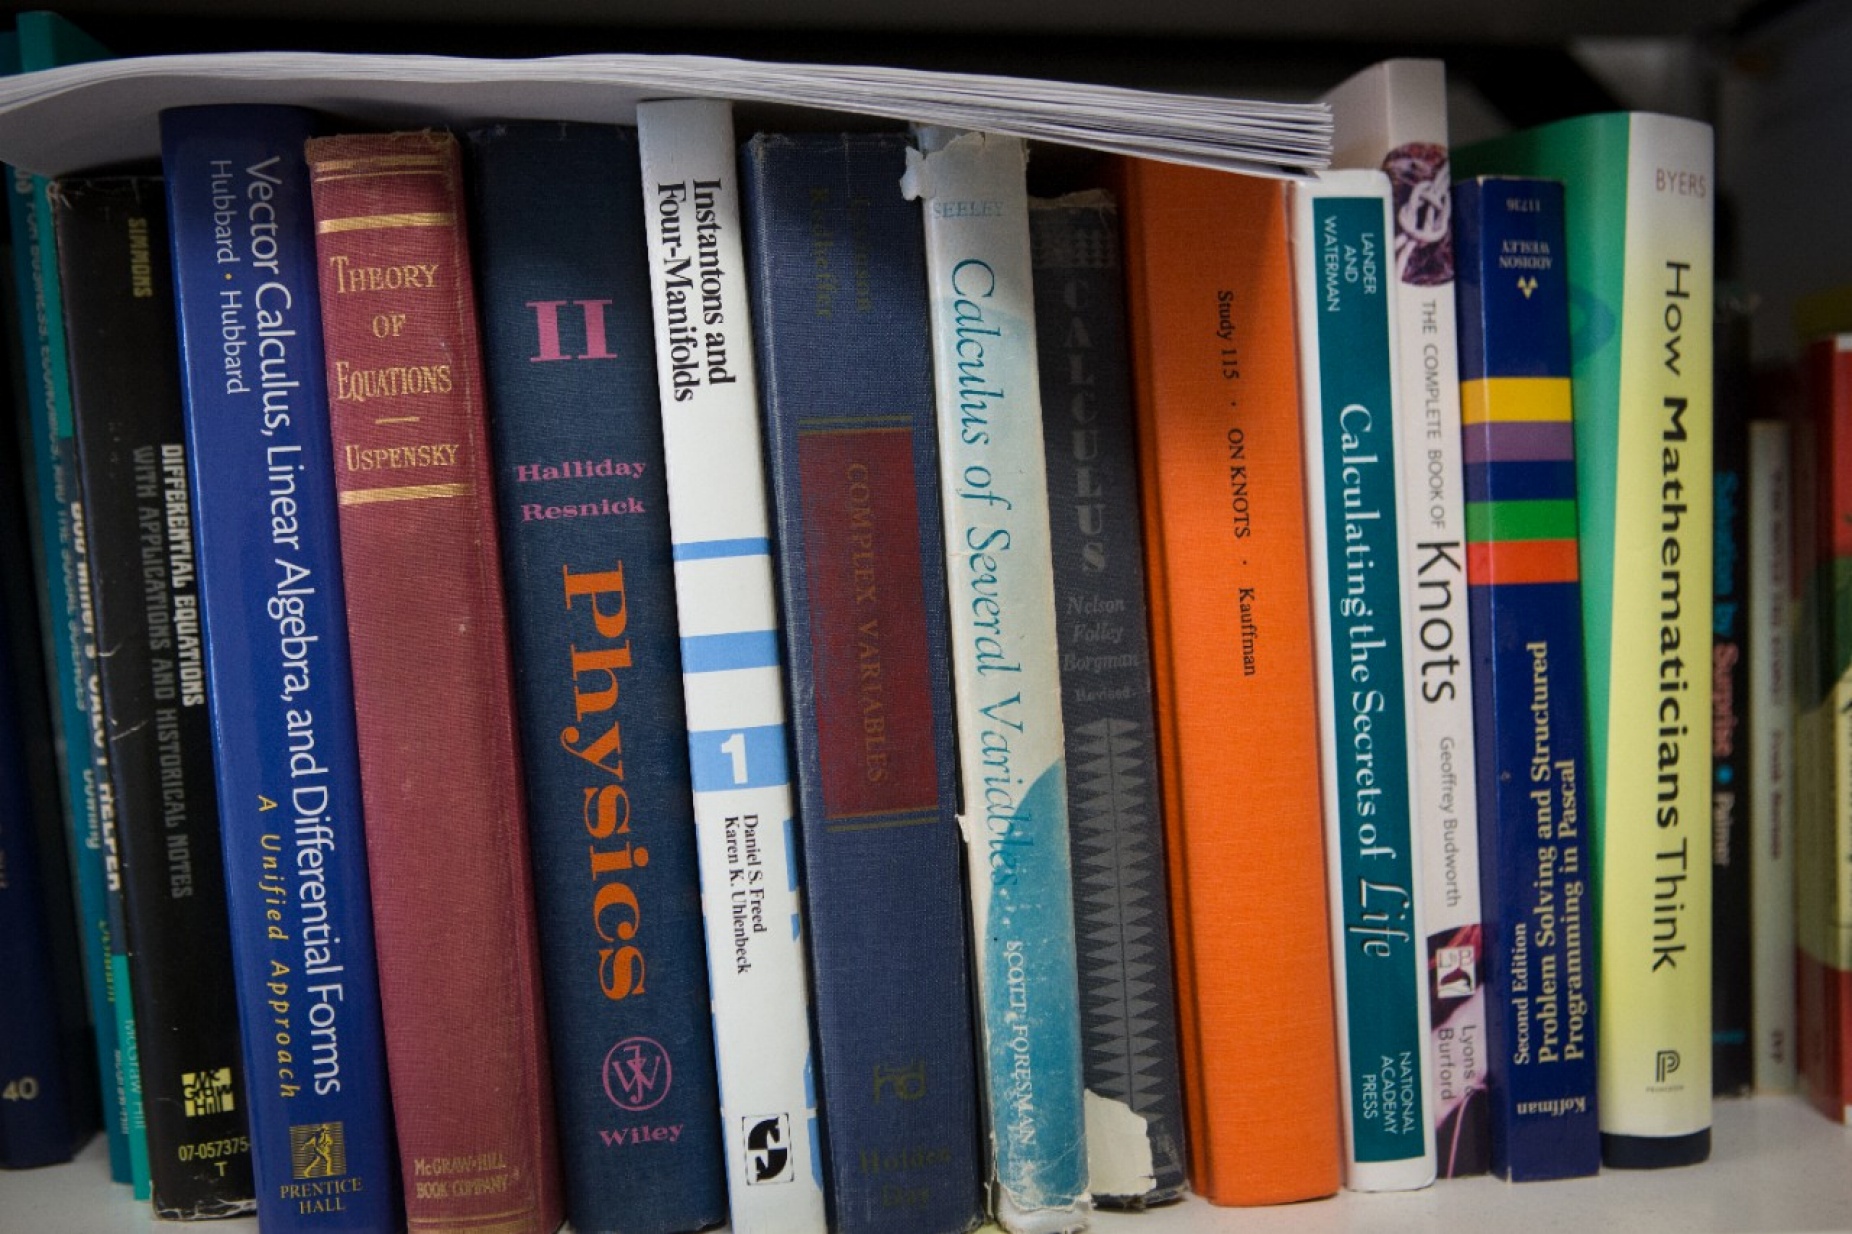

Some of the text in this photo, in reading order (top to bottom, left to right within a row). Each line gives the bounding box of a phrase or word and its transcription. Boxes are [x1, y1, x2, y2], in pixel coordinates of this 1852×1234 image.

[934, 201, 1003, 219] SEELEY
[1656, 167, 1706, 198] BYERS
[128, 217, 153, 298] SIMMONS
[210, 159, 250, 394] Hubbard Hubbard
[330, 256, 440, 293] THEORY
[693, 178, 736, 385] Instantons and
[1325, 216, 1340, 312] WATERMAN
[1344, 245, 1357, 282] AND
[1361, 233, 1376, 294] LANDER
[1499, 255, 1553, 269] ADDISON
[1502, 239, 1550, 254] WESLEY
[373, 313, 407, 338] OF
[525, 299, 617, 362] II
[657, 181, 700, 402] Four-Manifolds
[336, 362, 452, 402] EQUATIONS
[346, 444, 458, 472] USPENSKY
[1064, 280, 1106, 574] CALCULUS
[516, 459, 646, 482] Halliday
[521, 498, 645, 523] Resnick
[1216, 290, 1258, 676] Study 115 ON KNOTS Kauffman
[1417, 300, 1461, 704] THE COMPLETE BOOK OF Knots
[161, 444, 204, 707] DIFFERENTIAL EQUATIONS
[951, 258, 1034, 886] Calculus of Several Variables
[1066, 595, 1125, 614] Nelson
[245, 155, 344, 1095] Vector Calculus, Linear Algebra, and Differential Forms
[848, 463, 888, 783] COMPLEX VARIABLES
[1652, 261, 1690, 973] How Mathematicians Think
[132, 445, 193, 899] WITH APPLICATIONS AND HISTORICAL NOTES
[1340, 404, 1410, 957] Calculating the Secrets of Life
[560, 560, 649, 1000] Physics
[721, 733, 748, 784] 1
[1440, 737, 1459, 908] Geoffrey Budworth
[1527, 641, 1558, 1063] Problem Solving and Structured
[725, 817, 753, 974] Karen K. Uhlenbeck
[743, 814, 767, 934] Daniel S. Freed
[1555, 759, 1588, 1060] Programming in Pascal
[258, 794, 301, 1099] A Unified Approach
[1511, 923, 1529, 1065] Second Edition
[1012, 1025, 1036, 1146] FORESMAN
[1438, 1028, 1456, 1100] Burford
[1459, 1025, 1476, 1079] Lyons
[1362, 1074, 1378, 1119] PRESS
[1381, 1055, 1397, 1134] ACADEMY
[1400, 1051, 1416, 1135] NATIONAL
[1517, 1097, 1586, 1116] Koffman
[214, 1161, 228, 1177] T
[599, 1123, 684, 1148] Wiley
[280, 1178, 364, 1200] PRENTICE
[299, 1196, 347, 1215] HALL
[416, 1174, 507, 1198] BOOK COMPANY
